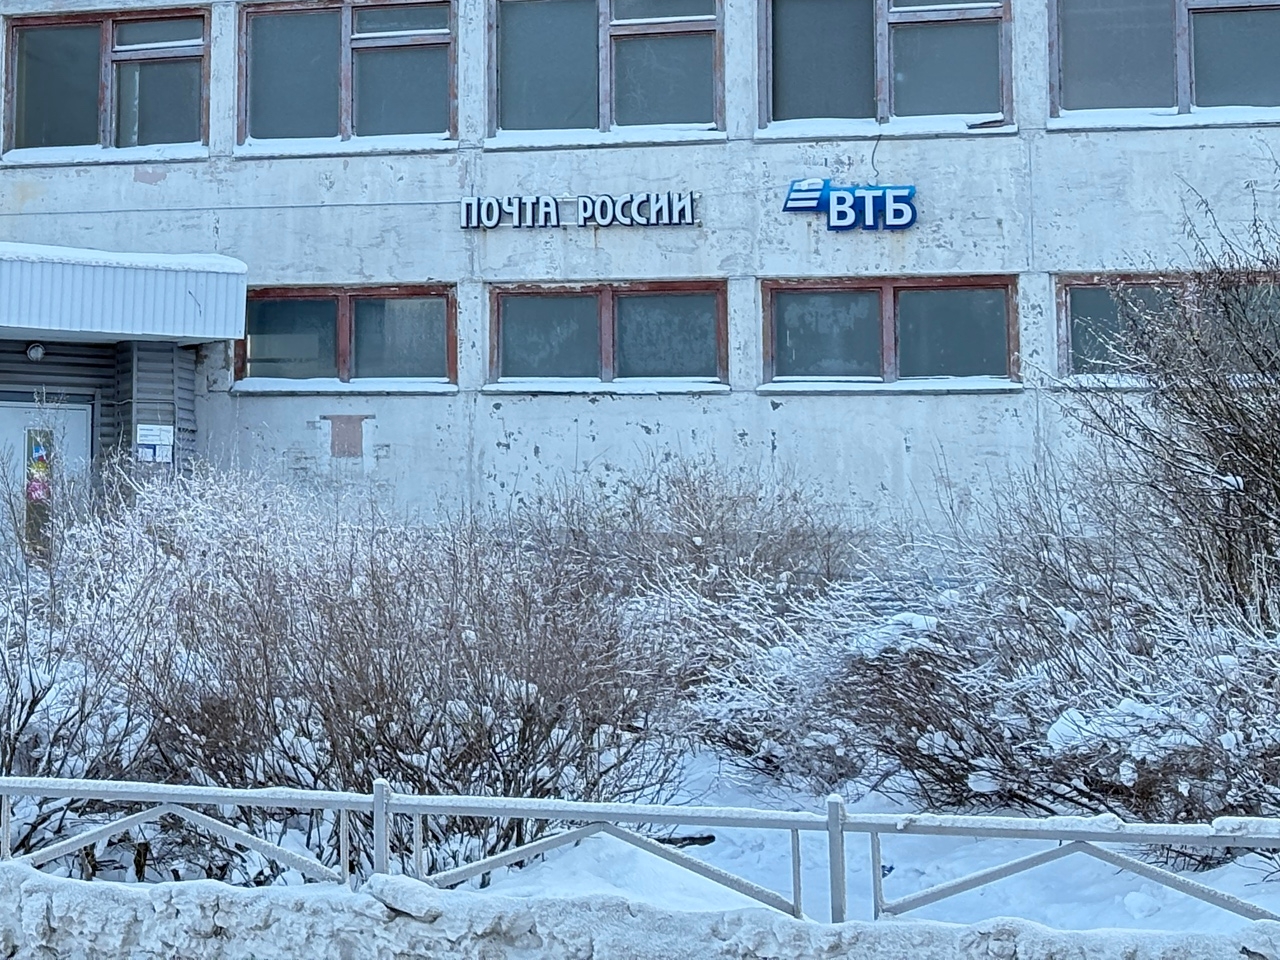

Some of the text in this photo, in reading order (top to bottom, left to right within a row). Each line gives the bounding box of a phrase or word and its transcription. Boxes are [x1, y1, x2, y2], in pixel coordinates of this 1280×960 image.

[459, 190, 695, 228] ПОЧТА РОССИИ
[827, 188, 915, 228] ВТБ
